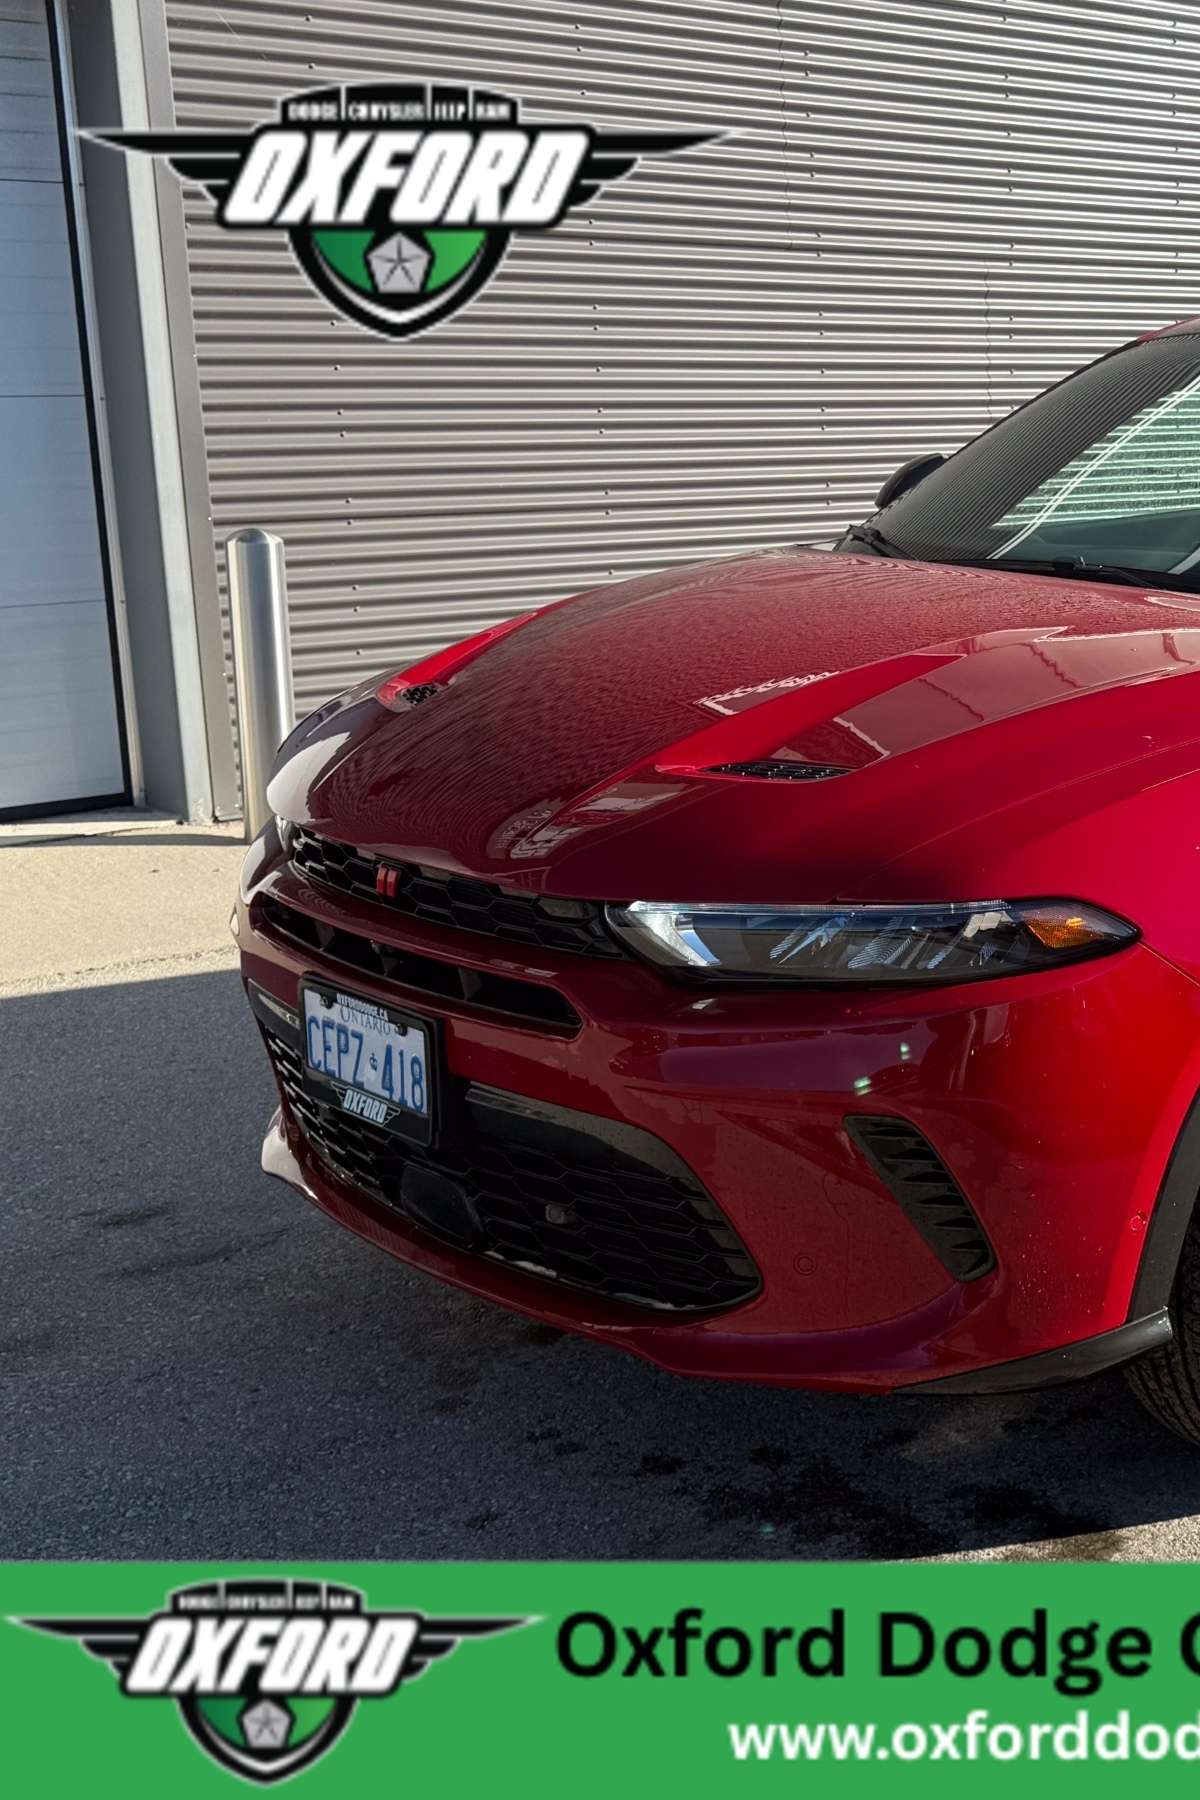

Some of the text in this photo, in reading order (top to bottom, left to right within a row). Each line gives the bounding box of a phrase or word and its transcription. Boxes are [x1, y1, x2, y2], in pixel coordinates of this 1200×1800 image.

[340, 1005, 391, 1036] ONTARIO
[307, 1015, 425, 1114] CEPZ 418
[343, 1089, 388, 1124] OXFORD
